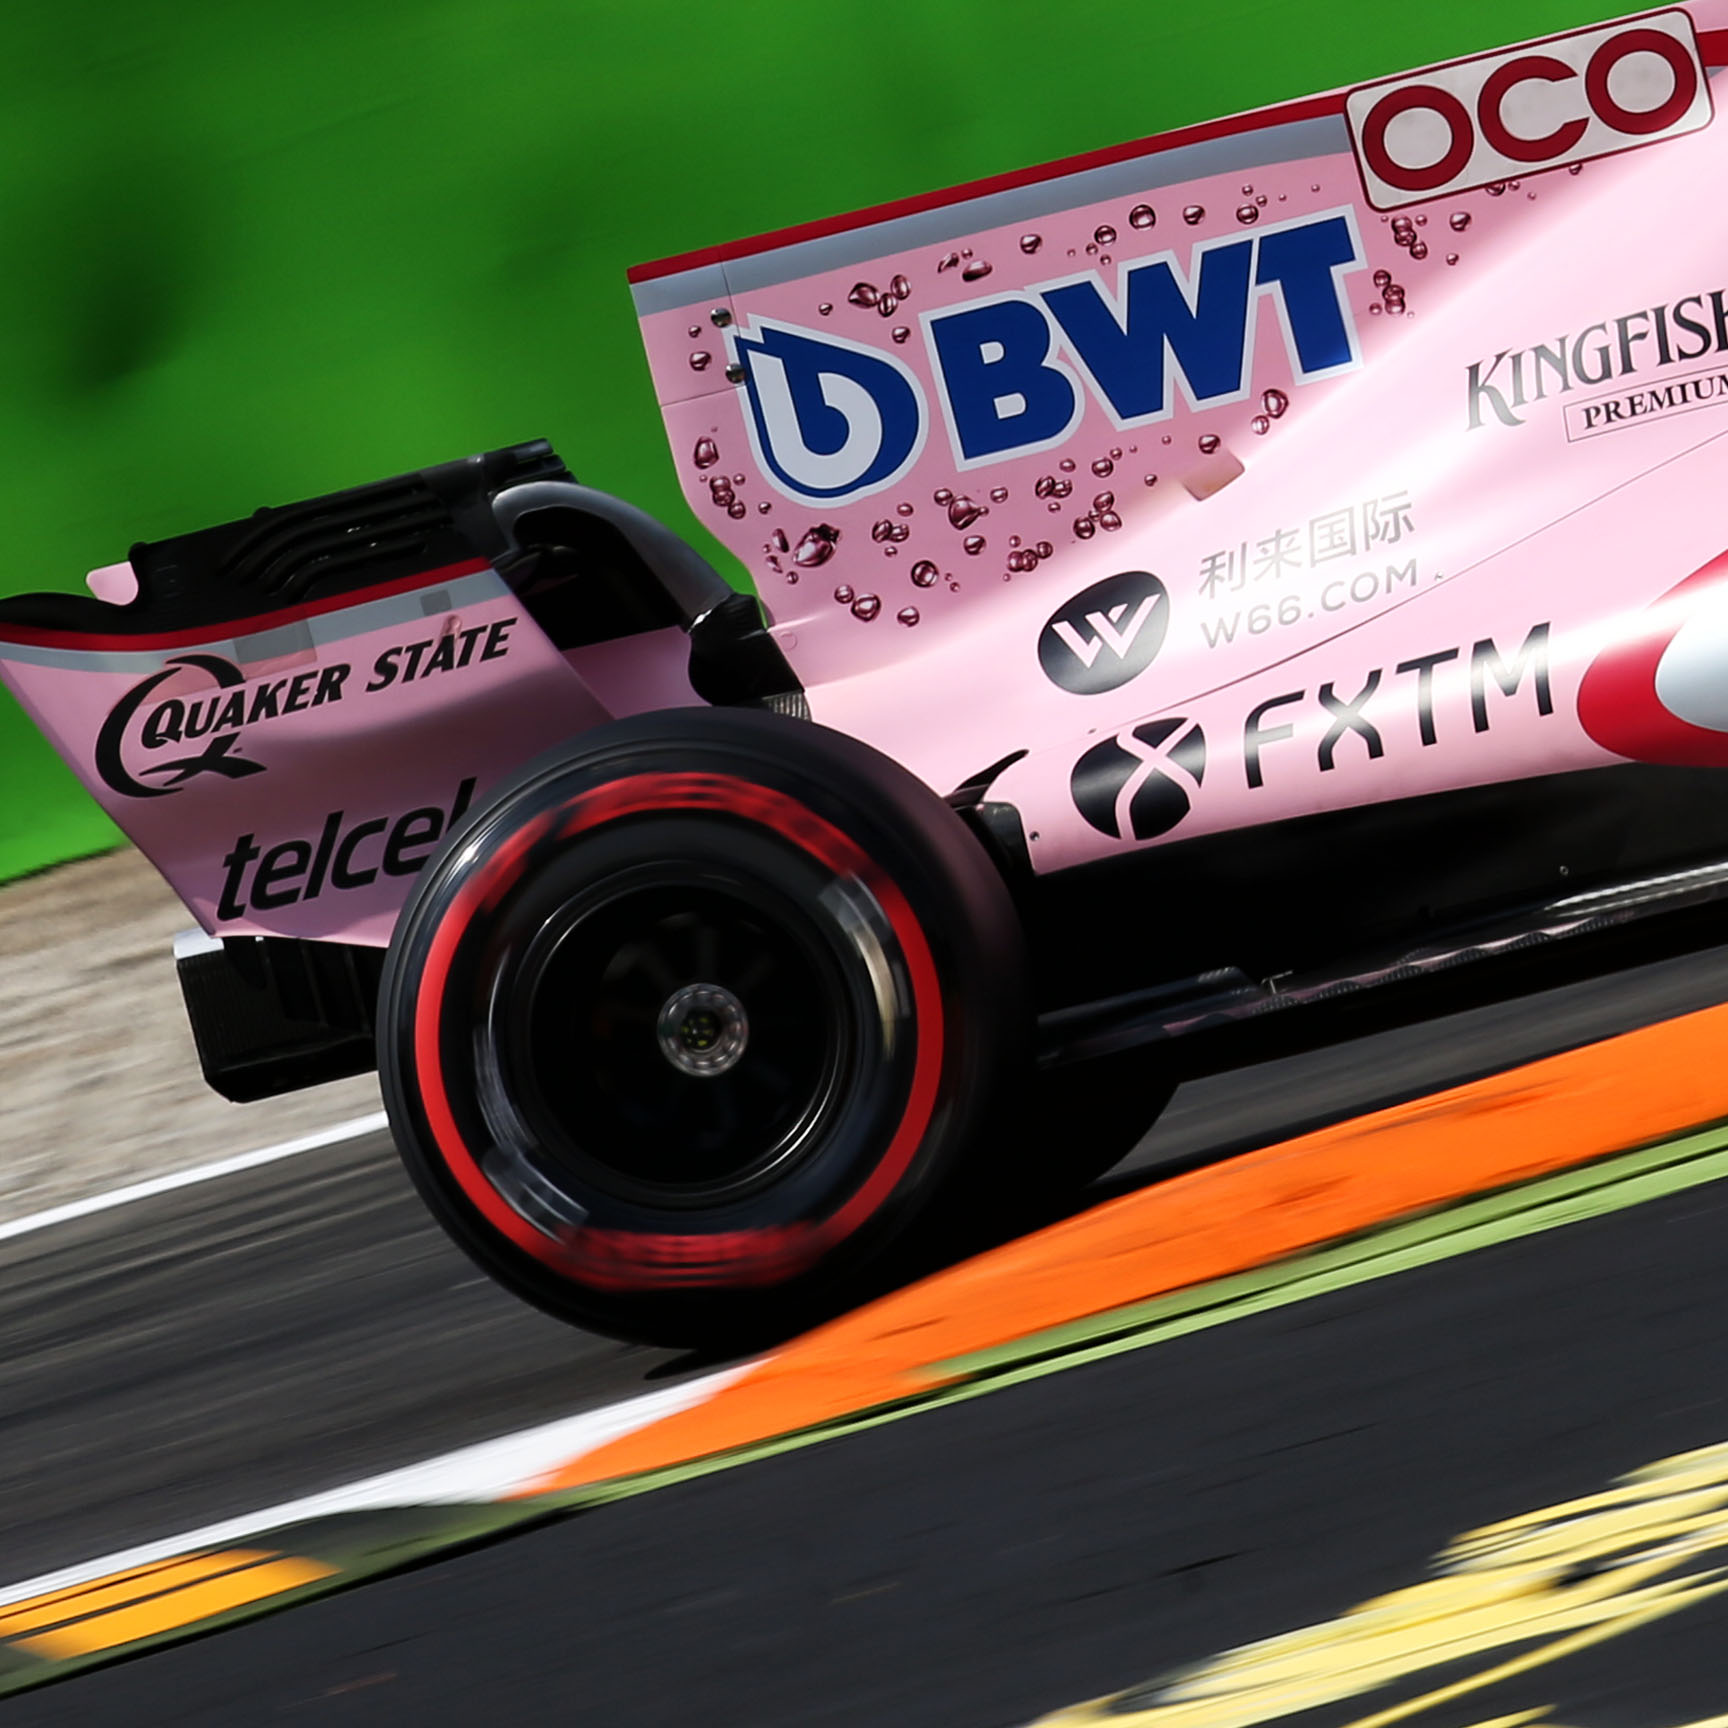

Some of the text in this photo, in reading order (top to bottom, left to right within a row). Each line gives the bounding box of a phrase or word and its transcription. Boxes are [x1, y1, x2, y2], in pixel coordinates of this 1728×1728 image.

[1362, 29, 1697, 190] OCO
[924, 210, 1362, 466] BWT
[1198, 489, 1415, 599] 利来国际
[1201, 558, 1417, 649] W66.COM
[141, 617, 518, 749] QUAKER STATE
[1243, 621, 1553, 789] FXTM
